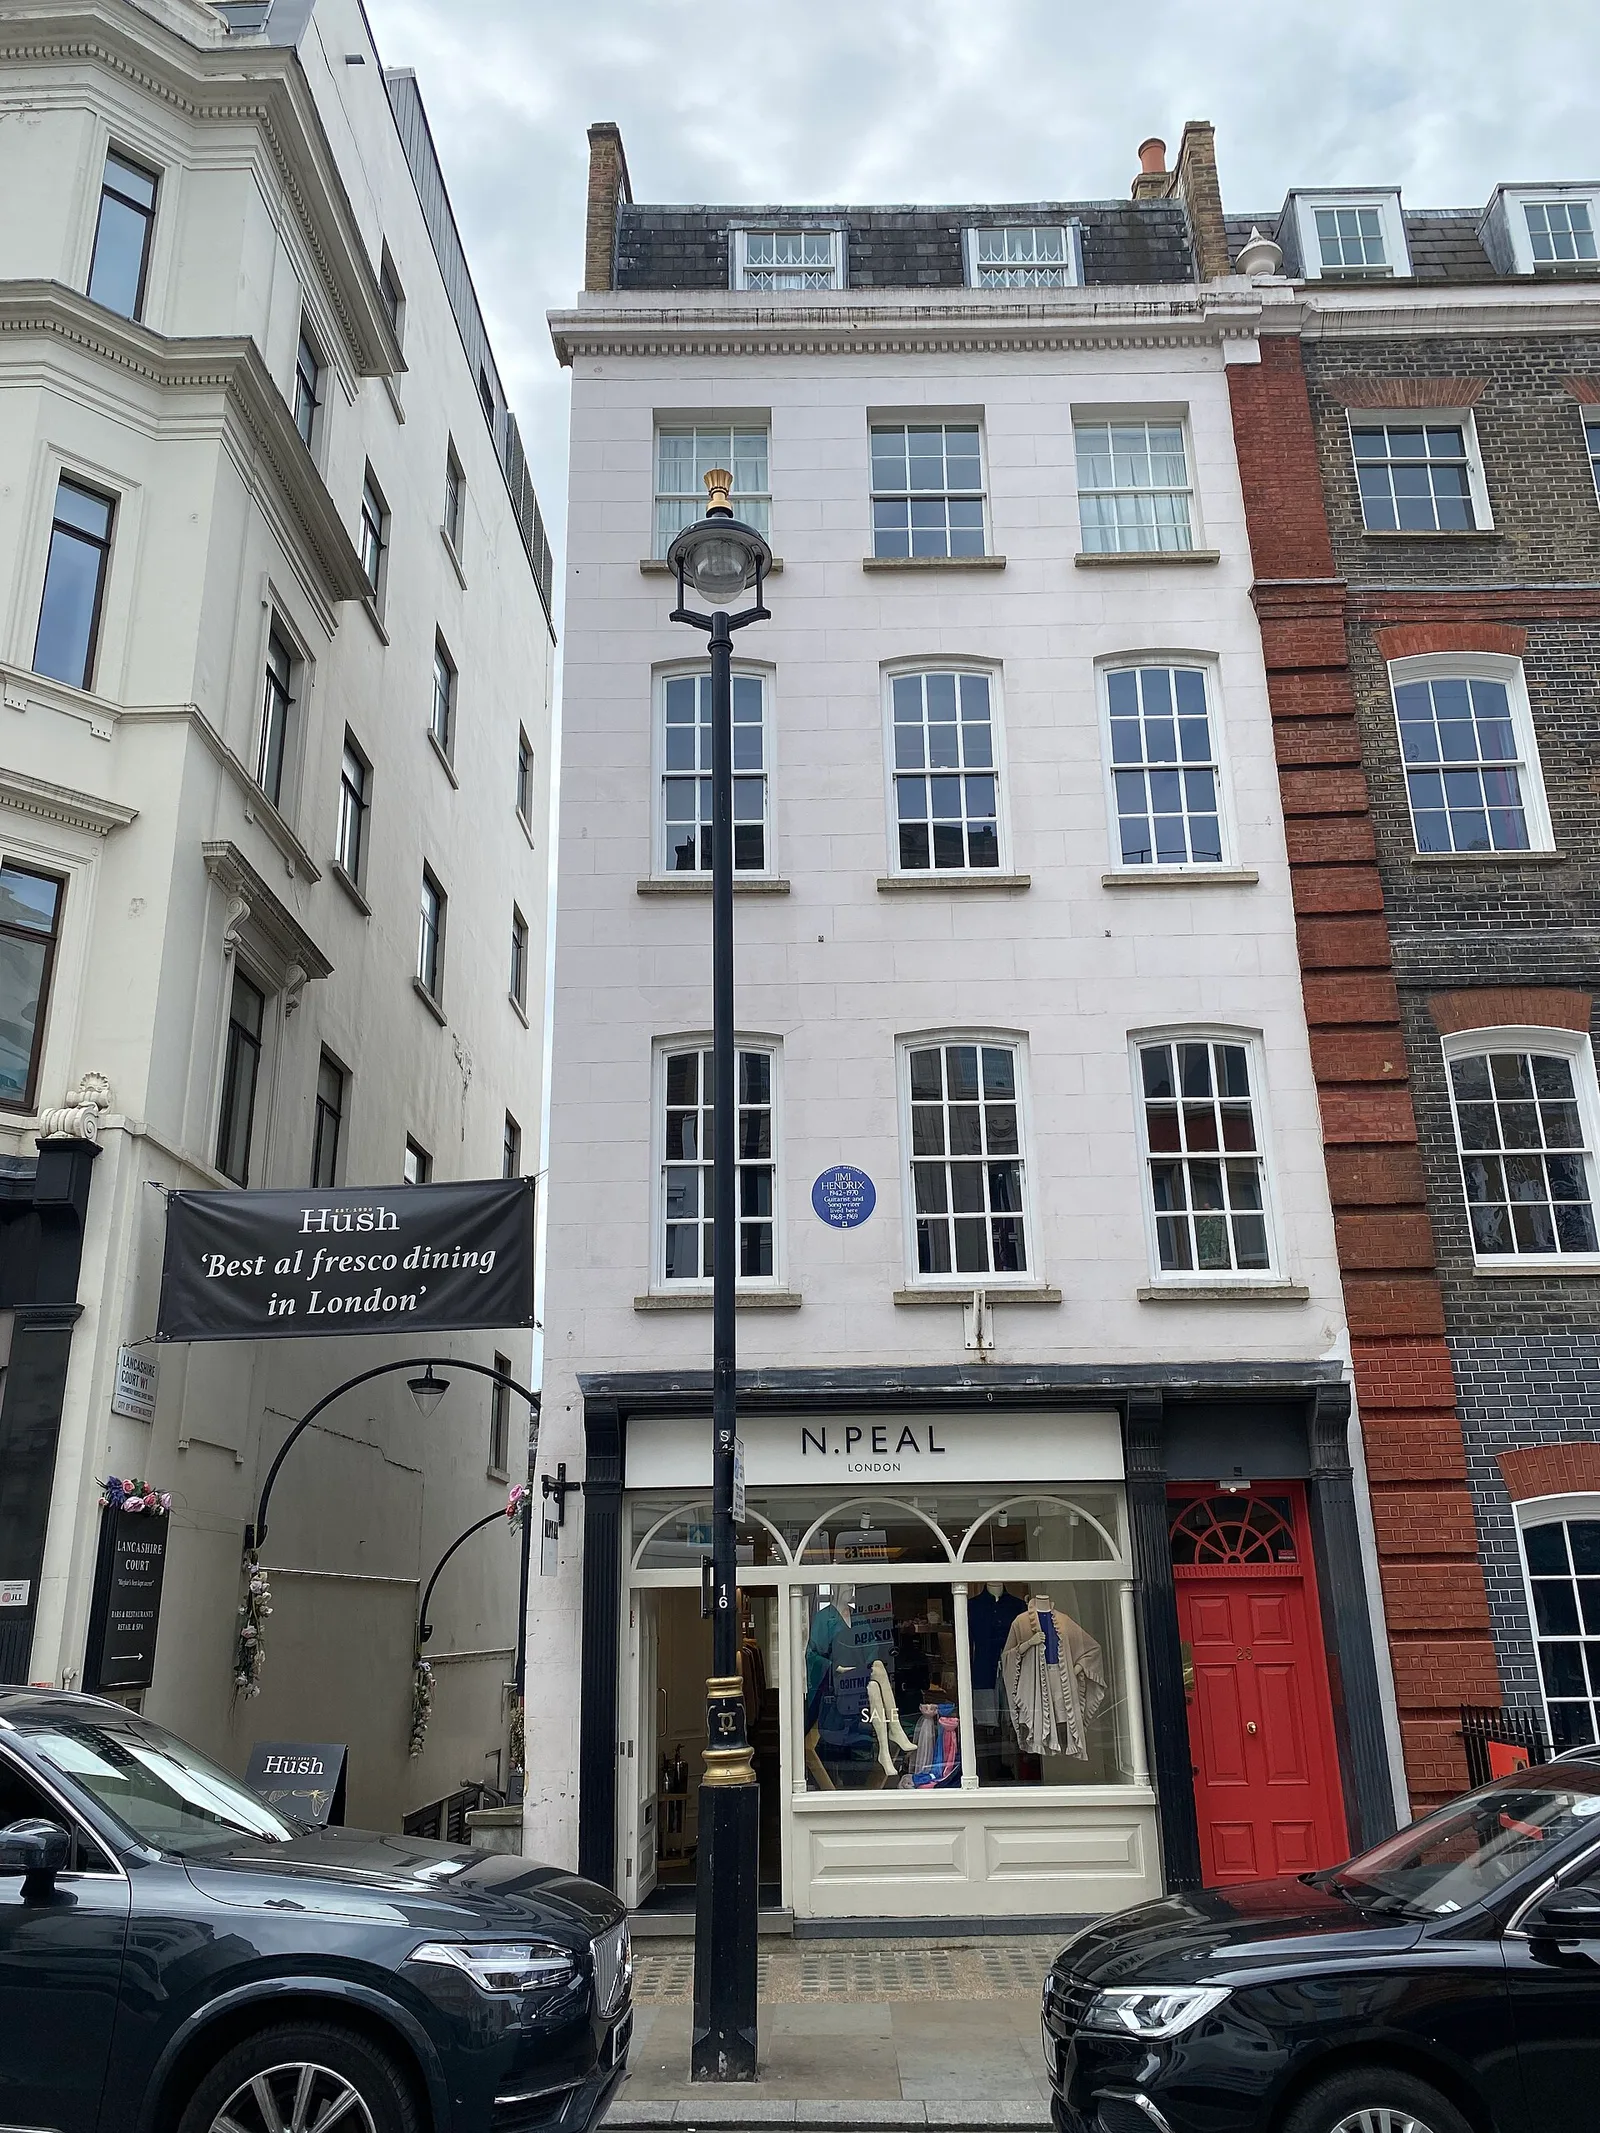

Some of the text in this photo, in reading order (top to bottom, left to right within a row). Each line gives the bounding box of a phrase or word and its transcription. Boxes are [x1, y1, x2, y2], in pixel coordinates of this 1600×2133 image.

[835, 1173, 851, 1181] JIMI
[821, 1181, 865, 1190] HENDRIX
[299, 1206, 400, 1233] Hush
[274, 1249, 303, 1275] al
[306, 1248, 398, 1281] fresco
[402, 1245, 496, 1274] dining
[267, 1292, 296, 1316] in
[122, 1355, 156, 1378] LANCASHIRE
[121, 1370, 149, 1390] COURT W1
[720, 1430, 729, 1442] S
[802, 1425, 946, 1454] N.PEAL
[848, 1463, 901, 1472] LONDON
[117, 1541, 163, 1555] LANCASHIRE
[125, 1559, 150, 1571] COURT
[11, 1593, 23, 1601] JLL
[111, 1610, 122, 1618] BARS
[126, 1610, 154, 1618] RESTAURANTS
[117, 1623, 131, 1631] RETAIL
[136, 1623, 144, 1631] SPA
[1236, 1646, 1253, 1660] 23
[861, 1708, 900, 1723] SALE
[263, 1755, 324, 1775] Hush
